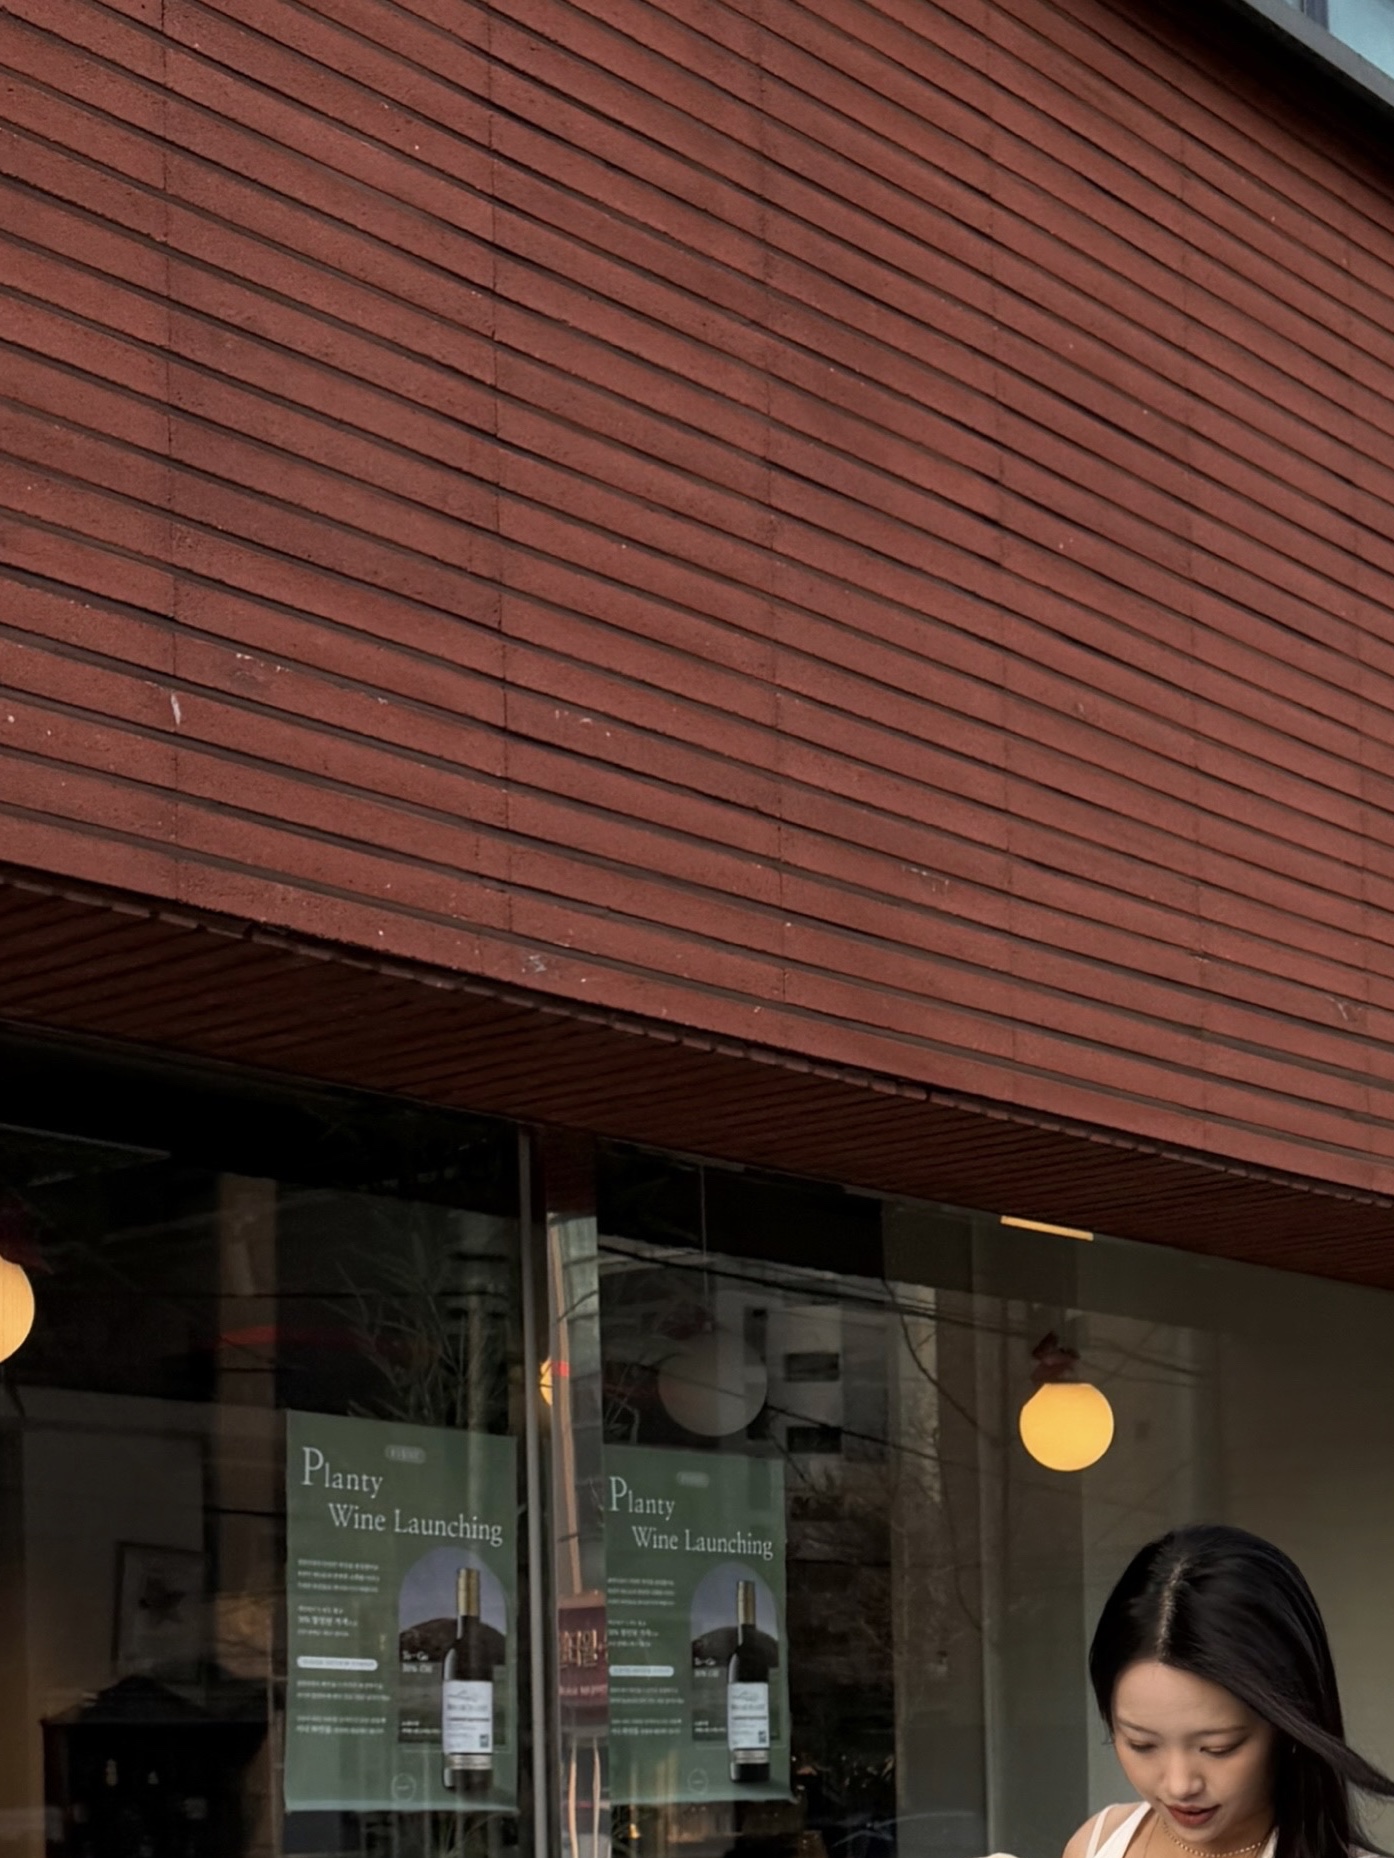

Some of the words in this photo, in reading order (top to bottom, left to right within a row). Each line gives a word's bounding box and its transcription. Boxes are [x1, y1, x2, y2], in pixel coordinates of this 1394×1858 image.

[302, 1447, 383, 1498] Planty
[609, 1476, 675, 1521] Planty
[328, 1502, 387, 1532] Wine
[394, 1508, 503, 1547] Launching
[631, 1525, 679, 1551] Wine
[685, 1529, 774, 1560] Launching
